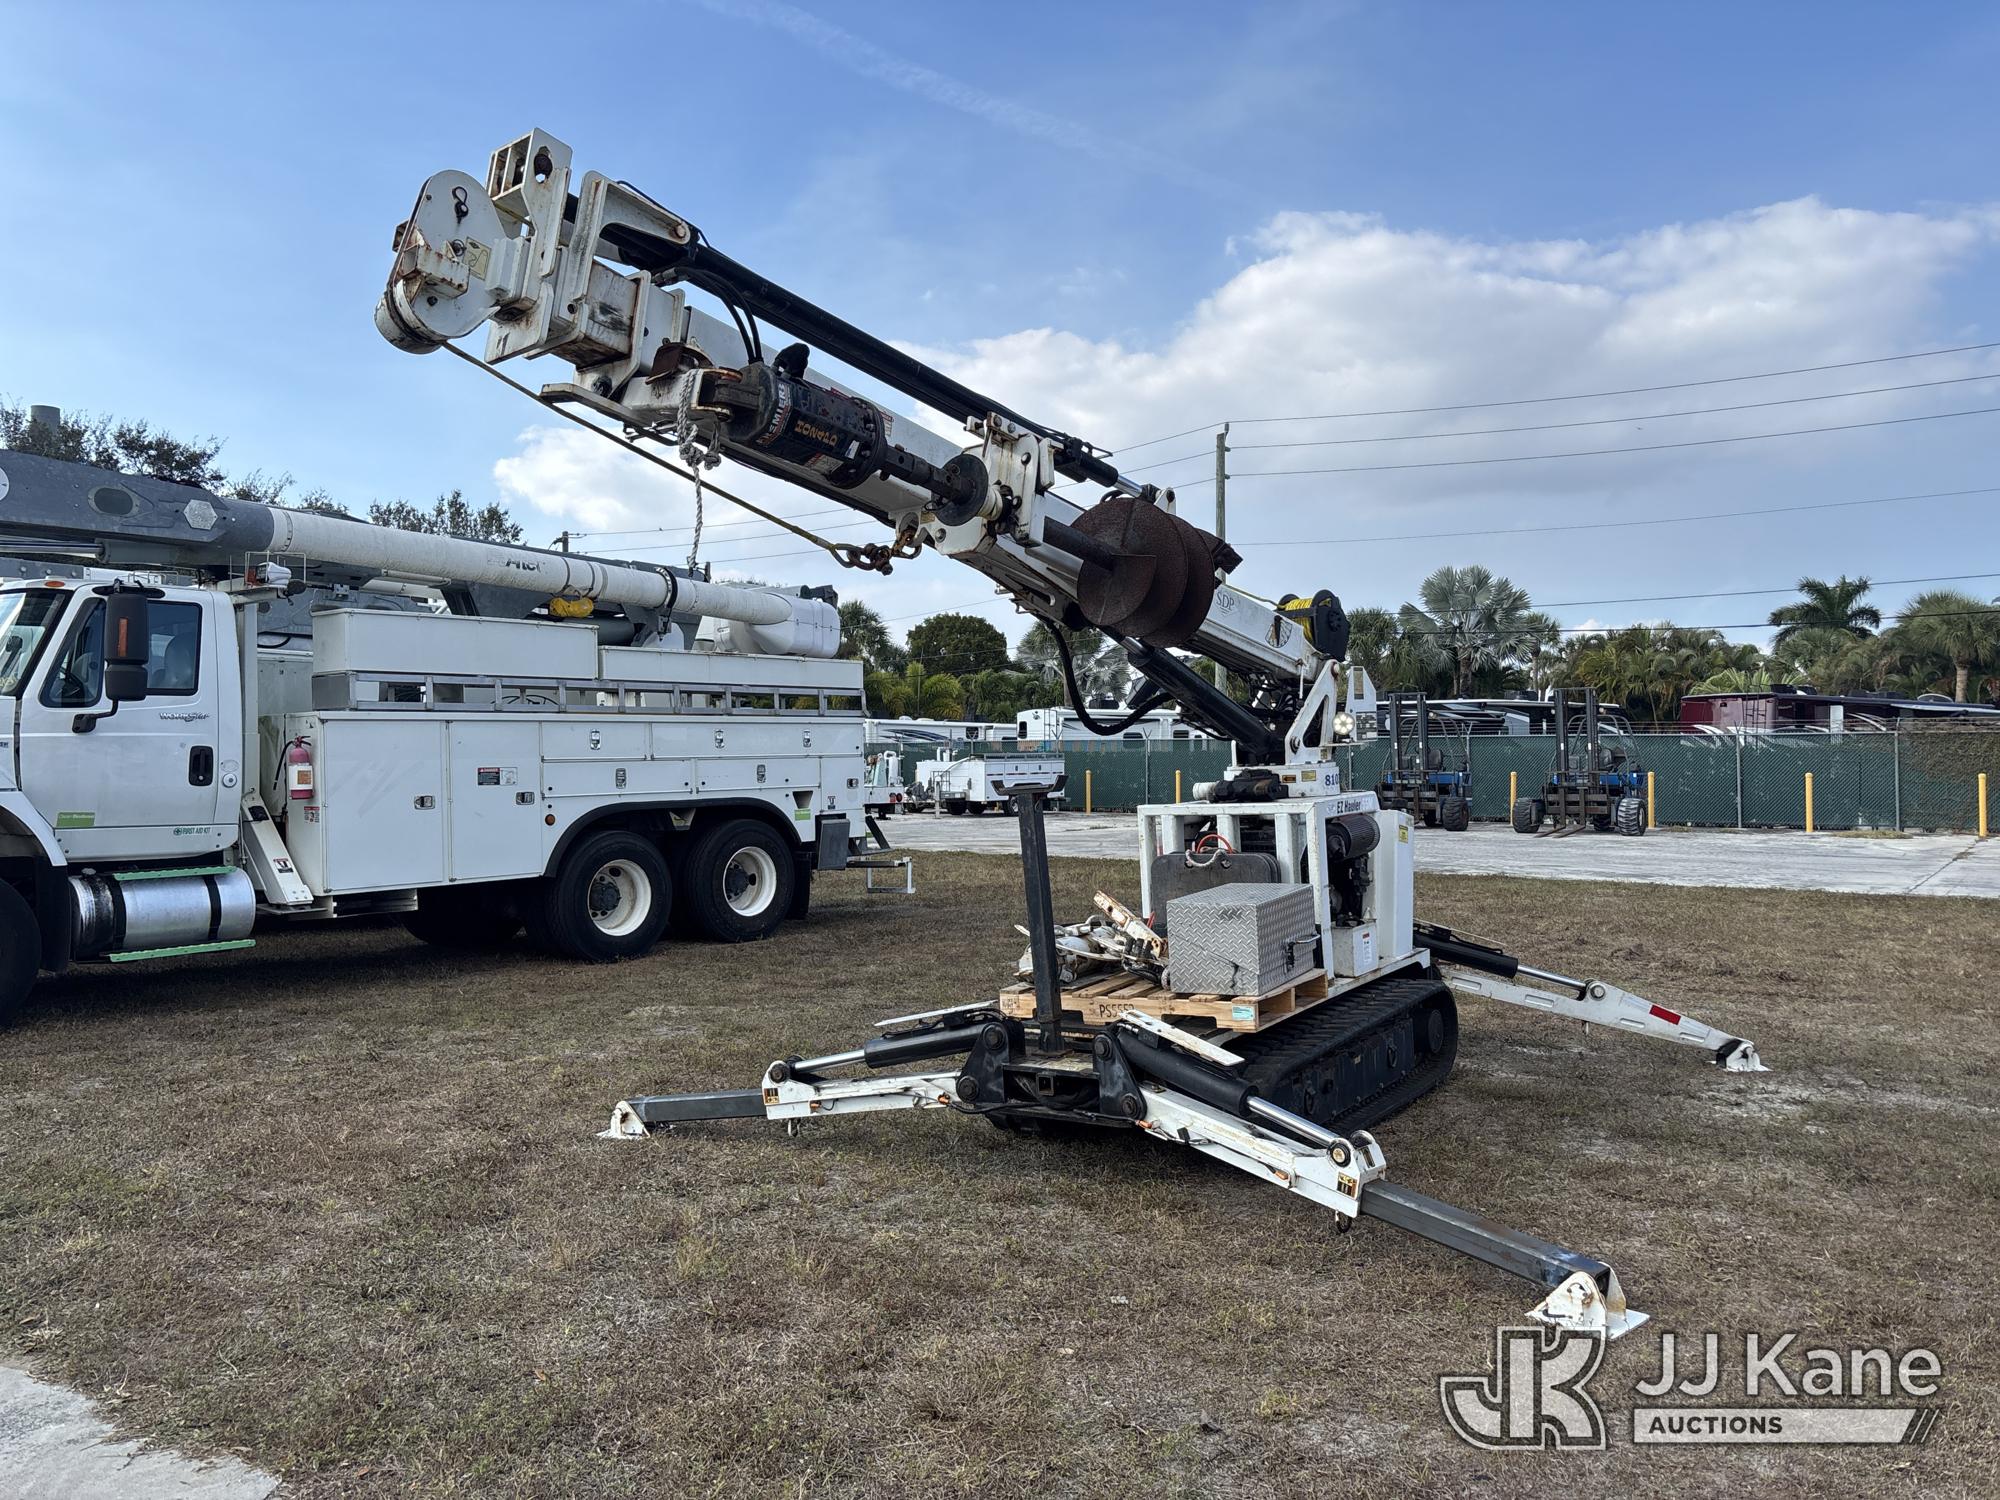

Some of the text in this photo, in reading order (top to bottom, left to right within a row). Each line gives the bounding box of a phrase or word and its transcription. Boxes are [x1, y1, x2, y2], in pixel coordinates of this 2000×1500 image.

[1216, 591, 1235, 612] SDP
[1337, 800, 1344, 814] EZ
[1344, 799, 1361, 812] Hauler
